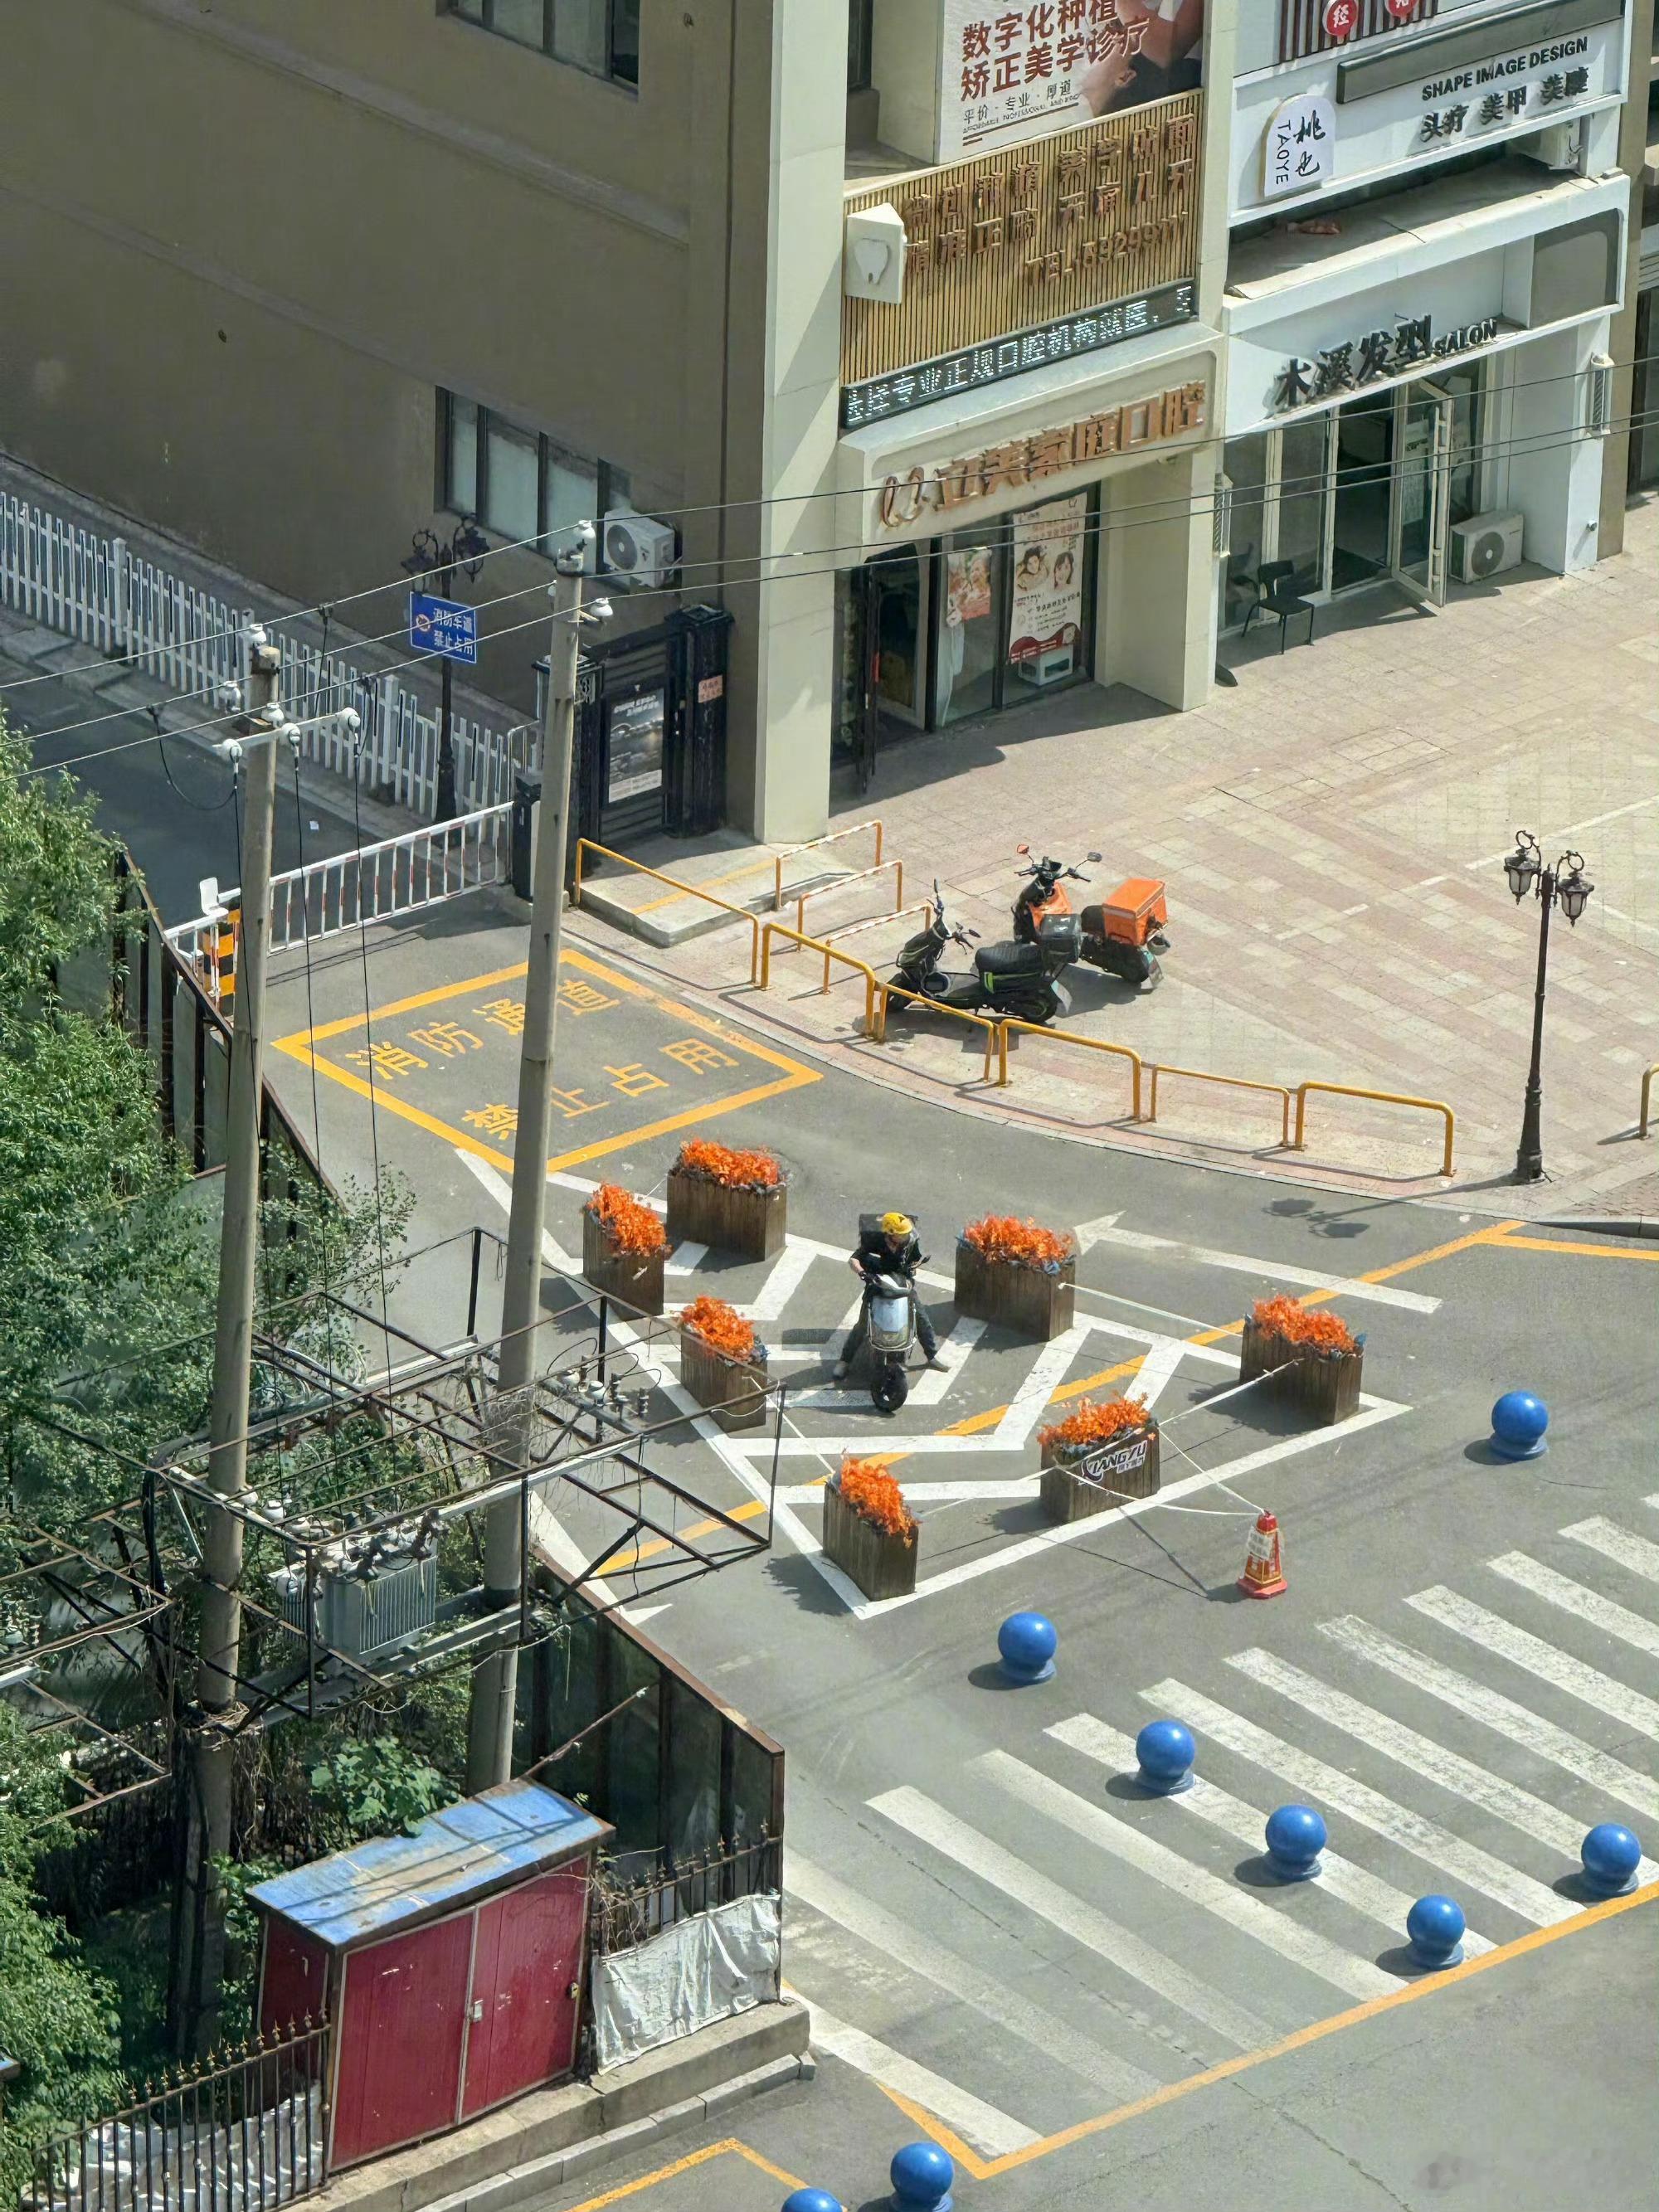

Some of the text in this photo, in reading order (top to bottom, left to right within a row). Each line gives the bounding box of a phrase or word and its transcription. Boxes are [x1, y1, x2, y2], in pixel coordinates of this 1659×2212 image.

[961, 17, 1150, 102] 矫正美学诊疗
[962, 0, 1118, 62] 数字化种植
[1422, 36, 1588, 101] SHAPE IMAGE DESIGN
[1419, 66, 1590, 143] 头疗 美甲 美睫
[1276, 119, 1292, 185] TAOYE
[1433, 318, 1498, 357] SALON
[433, 608, 473, 633] 消防车道
[434, 630, 473, 655] 禁止占用
[345, 979, 620, 1079] 消防通道
[462, 1038, 739, 1140] 禁止占用
